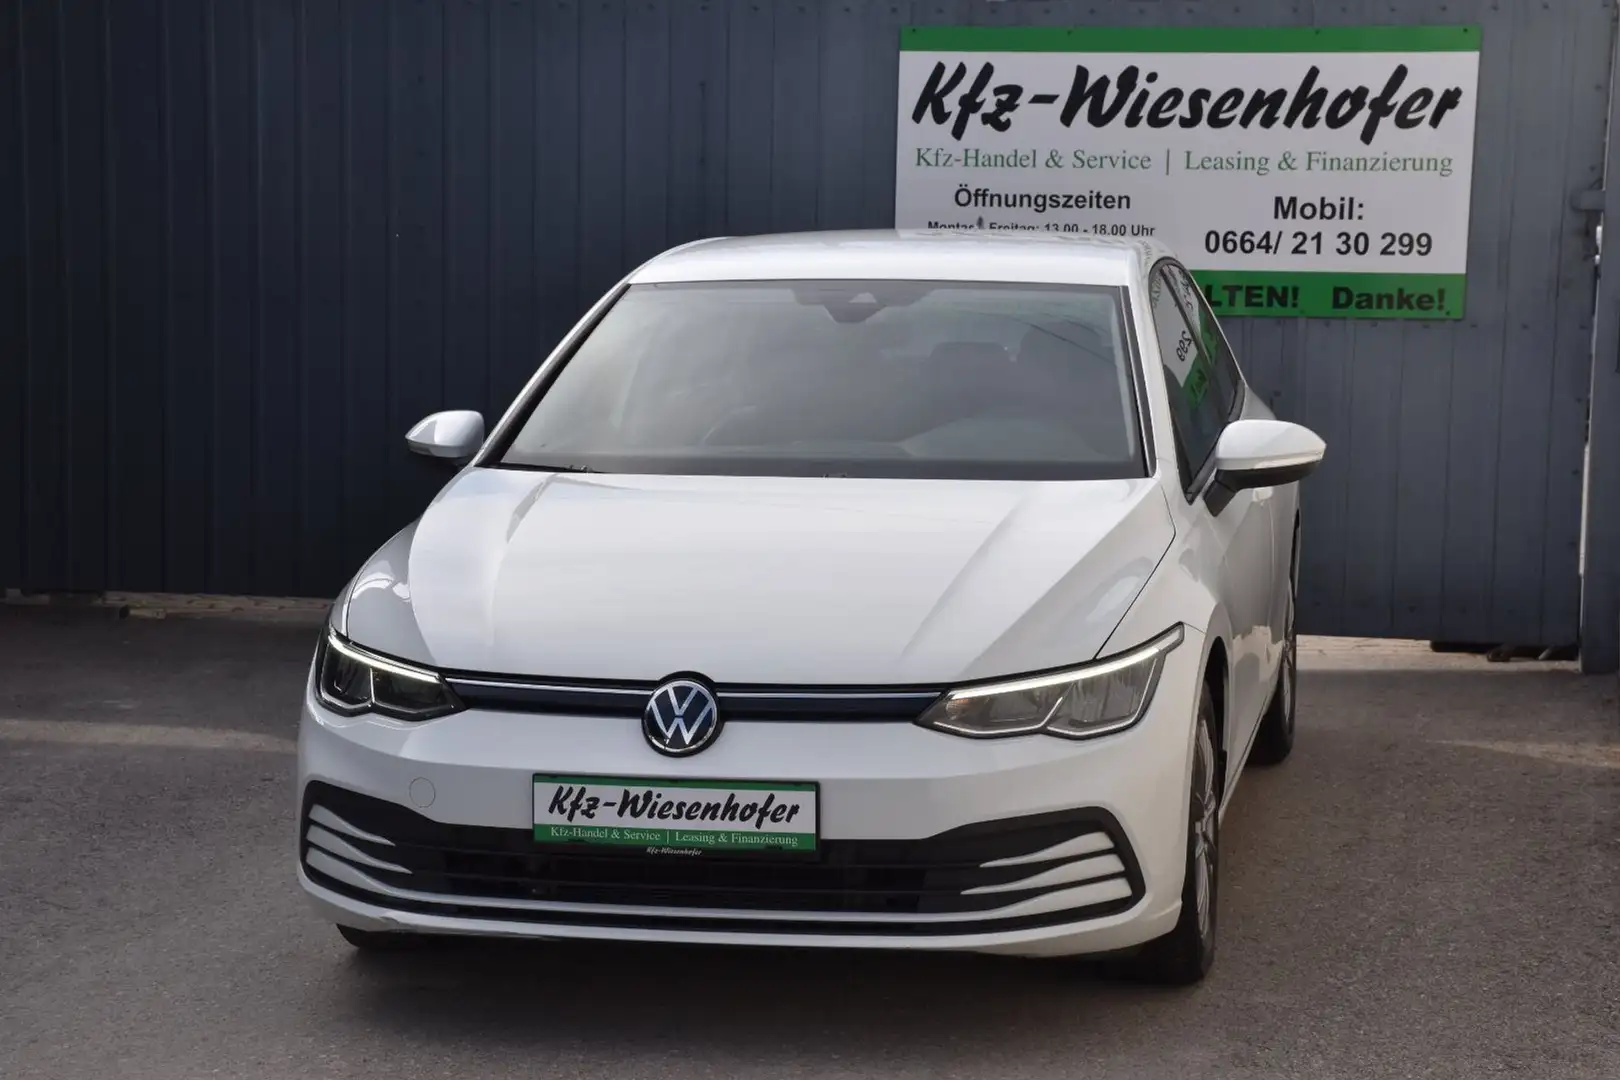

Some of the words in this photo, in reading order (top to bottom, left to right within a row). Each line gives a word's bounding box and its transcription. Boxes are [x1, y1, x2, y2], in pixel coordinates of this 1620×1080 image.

[911, 60, 1462, 145] Kfz-Wiesenhofer
[915, 148, 1037, 168] Kfz-Handel
[1045, 150, 1064, 168] &
[1072, 149, 1152, 169] Service
[1184, 150, 1270, 176] Leasing
[1277, 151, 1298, 171] &
[1305, 151, 1454, 177] Finanzierung
[953, 183, 1131, 213] Öffnungszeiten
[1273, 196, 1364, 220] Mobil:
[1044, 223, 1079, 232] 1300
[1092, 223, 1126, 236] 18.00
[1130, 224, 1155, 237] Uhr
[1204, 229, 1282, 255] 0664/
[1291, 231, 1322, 255] 21
[1335, 231, 1370, 256] 30
[1380, 232, 1432, 256] 299
[1332, 286, 1446, 311] Danke!
[549, 785, 800, 829] Kfz-Wiesenhofer
[551, 826, 609, 839] Kfz-Handel
[611, 828, 621, 840] &
[623, 829, 661, 841] Service
[675, 832, 716, 845] Leasing
[718, 833, 728, 844] &
[731, 833, 798, 847] Finanzierung
